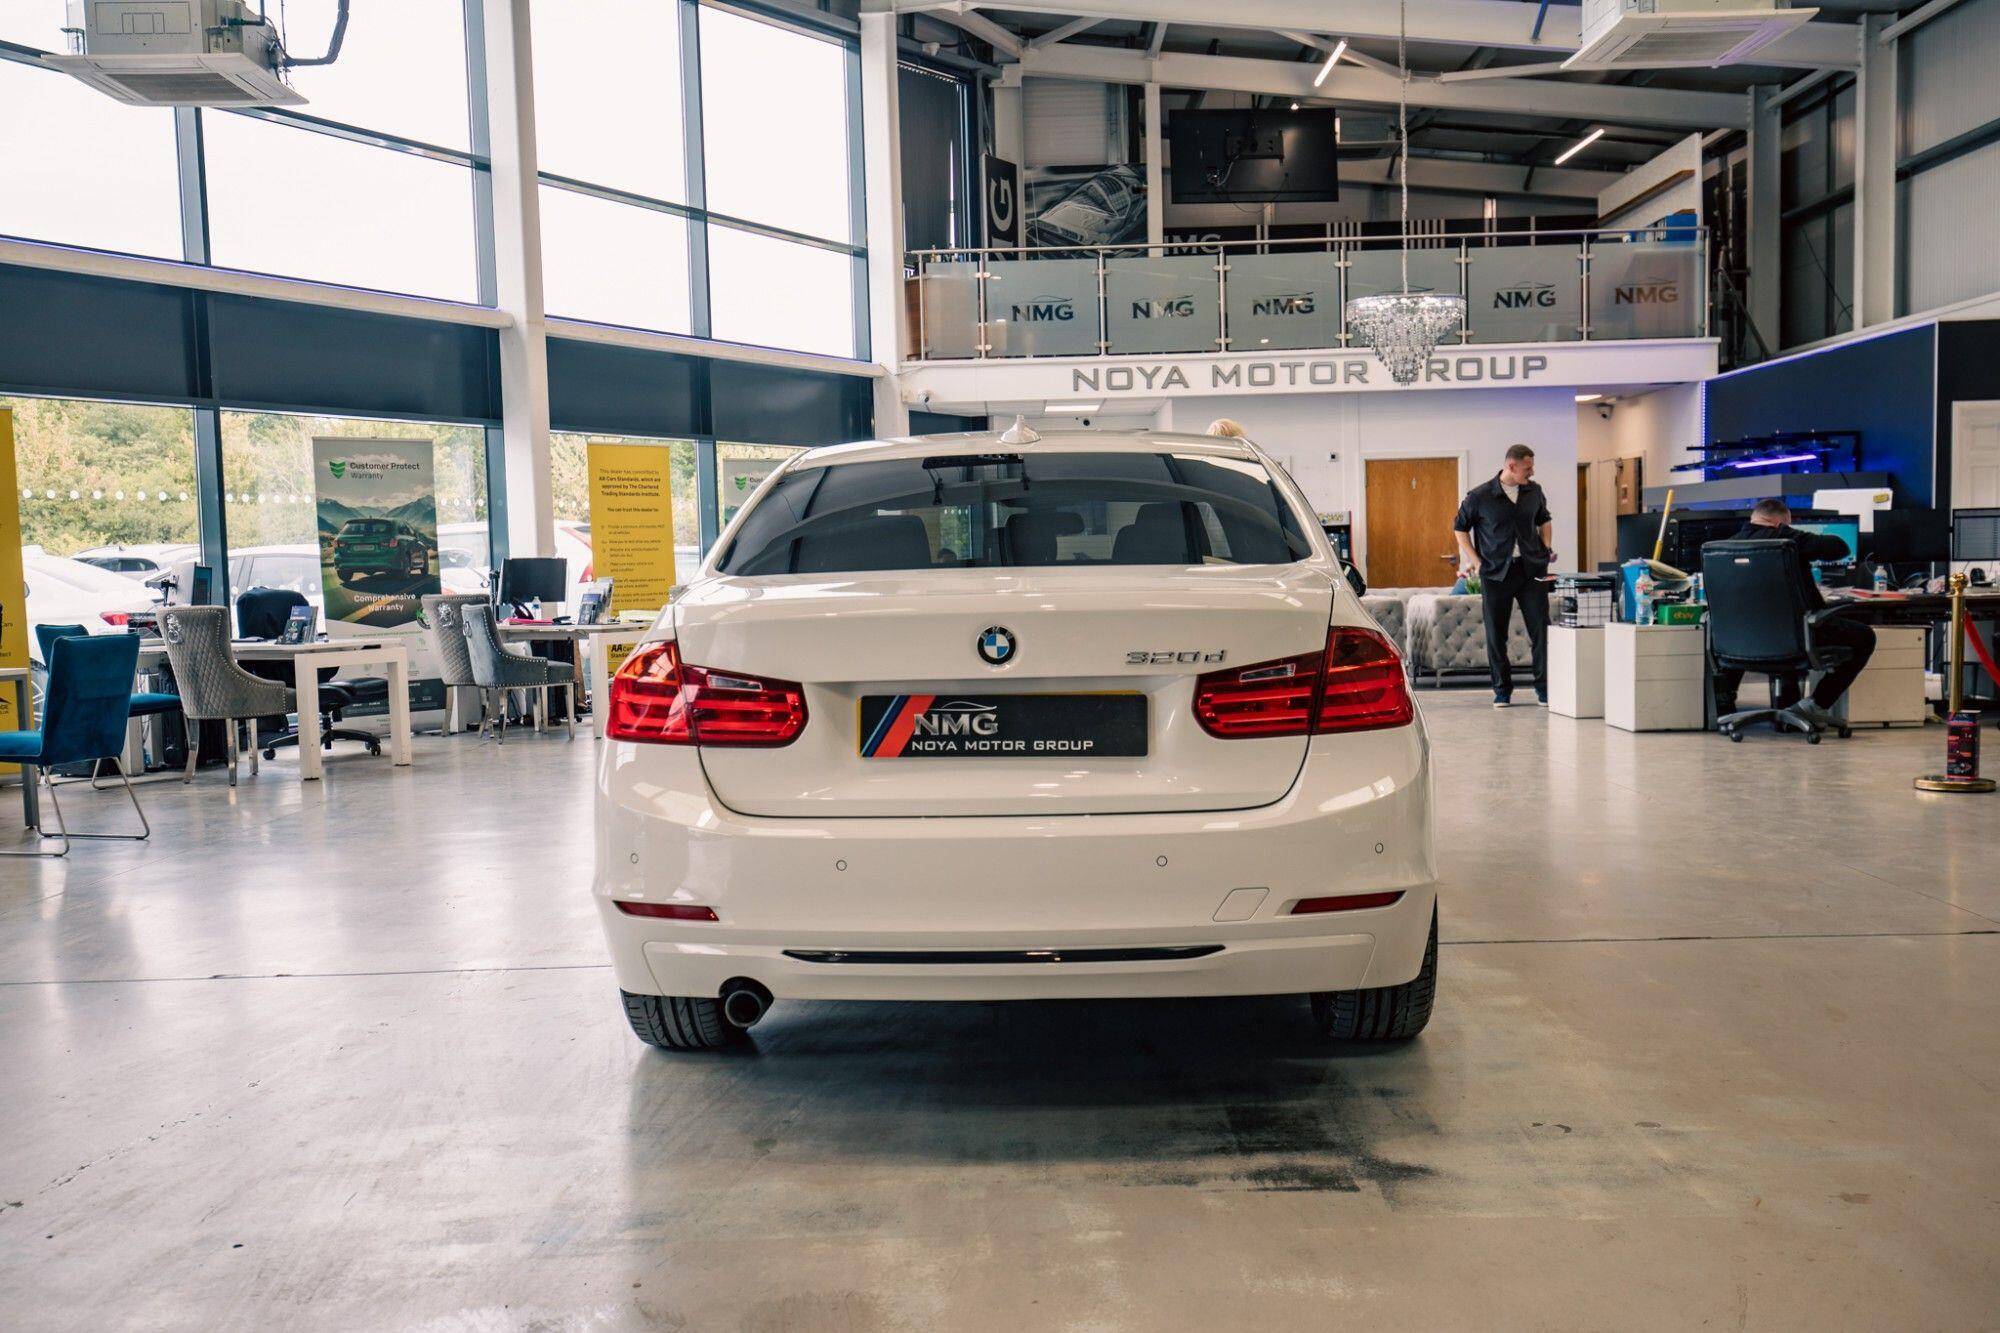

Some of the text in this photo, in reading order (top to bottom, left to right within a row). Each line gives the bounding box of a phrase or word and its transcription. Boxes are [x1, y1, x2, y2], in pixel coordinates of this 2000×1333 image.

[1494, 290, 1556, 309] NMG
[1615, 286, 1679, 304] NMG
[1011, 304, 1074, 321] NMG
[1132, 301, 1195, 319] NMG
[1253, 298, 1315, 316] NMG
[1072, 365, 1190, 392] NOYA
[1212, 361, 1369, 388] MOTOR
[350, 462, 420, 470] Customer Protect
[354, 592, 416, 603] Comprehensive
[368, 603, 404, 612] Warranty
[1125, 650, 1227, 664] 320d
[913, 713, 999, 736] NMG
[911, 740, 1094, 751] NOYA MOTOR GROUP
